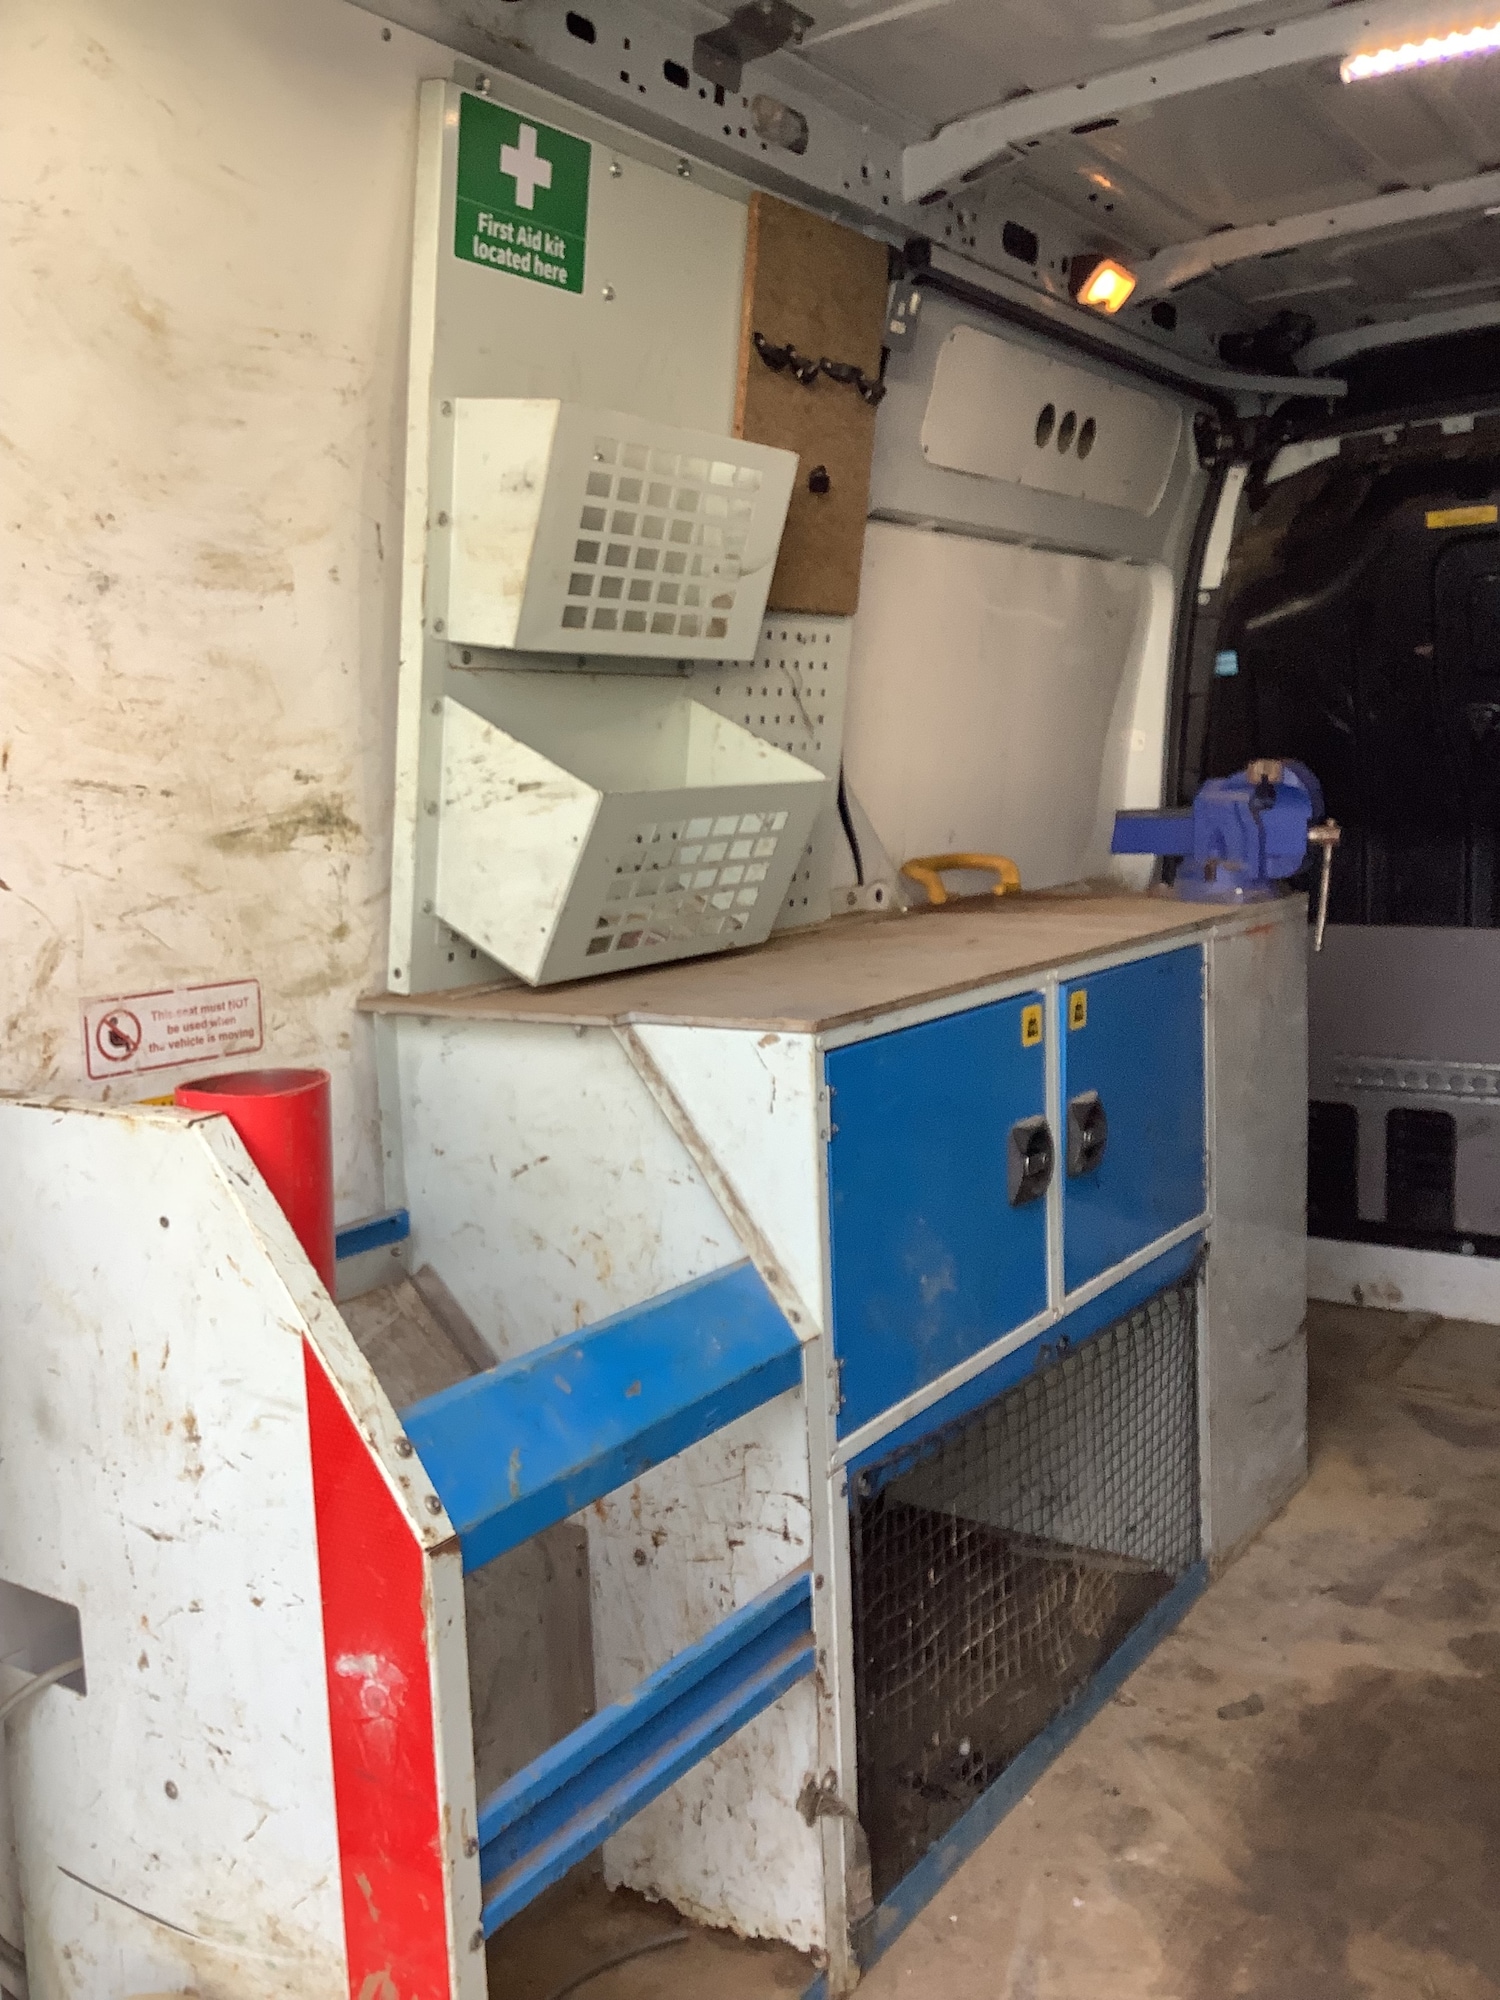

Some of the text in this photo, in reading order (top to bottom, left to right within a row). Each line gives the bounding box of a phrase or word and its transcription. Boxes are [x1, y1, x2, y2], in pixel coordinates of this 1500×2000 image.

[478, 212, 565, 260] First Aid kit
[473, 235, 568, 284] located here
[200, 1002, 225, 1014] must
[228, 997, 249, 1010] NOT
[167, 1024, 180, 1035] be
[183, 1019, 207, 1032] used
[168, 1035, 204, 1049] vehicle
[207, 1033, 216, 1043] is
[218, 1027, 255, 1042] moving
